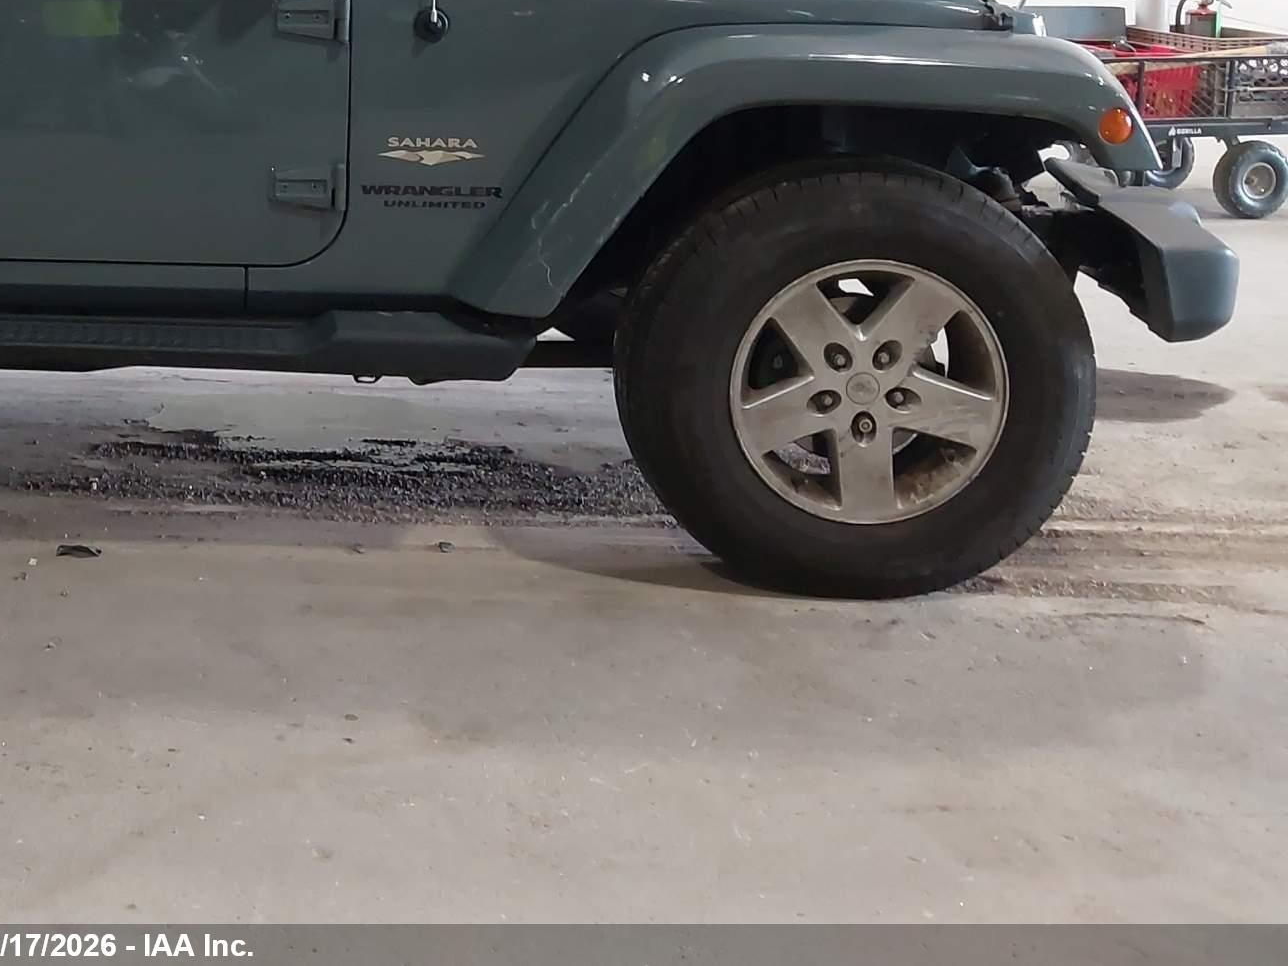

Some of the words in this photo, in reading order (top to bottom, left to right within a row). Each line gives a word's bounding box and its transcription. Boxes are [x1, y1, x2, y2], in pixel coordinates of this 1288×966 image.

[387, 136, 478, 148] SAHARA
[361, 185, 502, 198] WRANGLER
[384, 200, 485, 209] UNLIMITED
